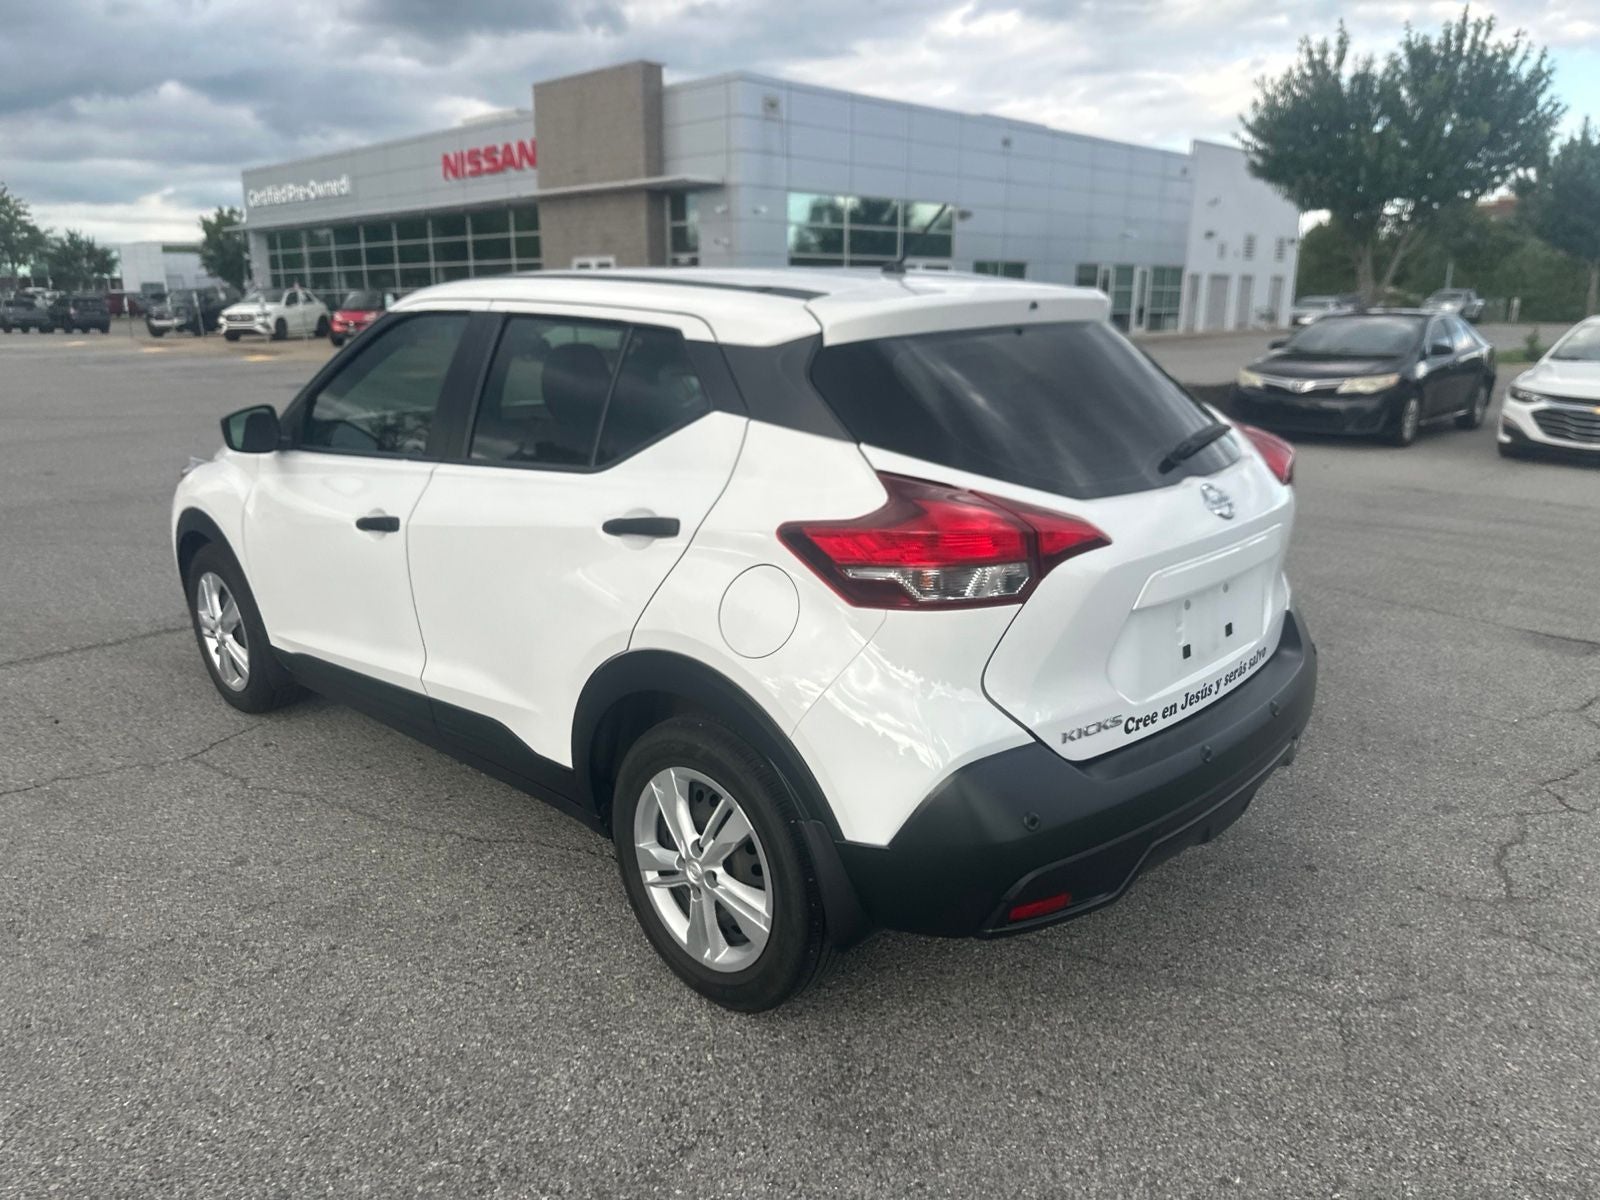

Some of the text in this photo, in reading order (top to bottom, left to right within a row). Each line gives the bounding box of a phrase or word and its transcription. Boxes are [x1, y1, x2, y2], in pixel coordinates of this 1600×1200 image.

[442, 137, 537, 181] NISSAN
[1124, 647, 1266, 734] Cree en Jesús y serás salvo
[1061, 714, 1123, 745] KICKS
